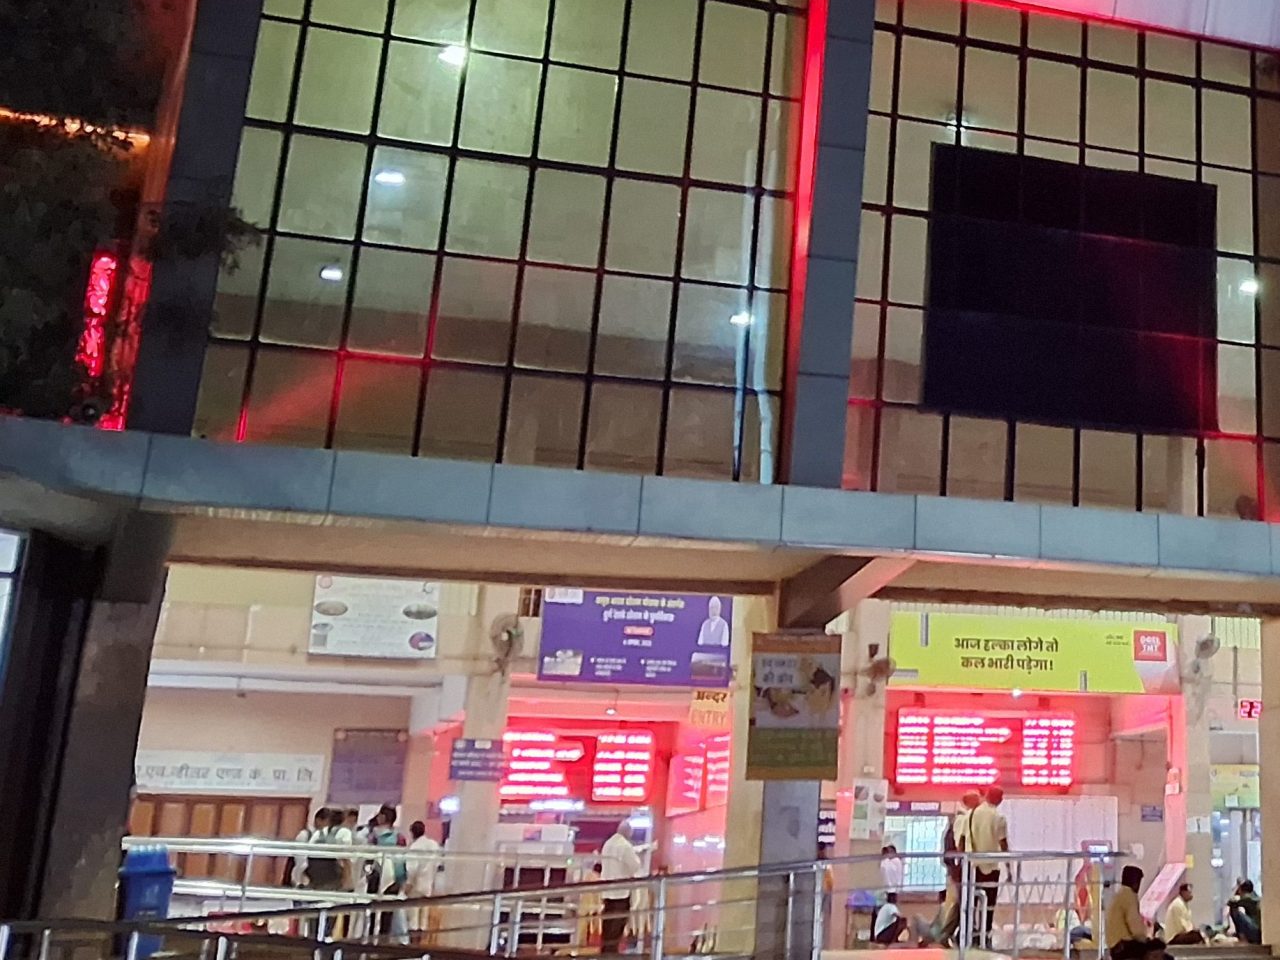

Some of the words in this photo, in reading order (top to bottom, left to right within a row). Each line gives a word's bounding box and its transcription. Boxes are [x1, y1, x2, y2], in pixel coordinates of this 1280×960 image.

[954, 637, 981, 651] आज
[983, 637, 1015, 652] हल्का
[1017, 636, 1044, 653] लोगे
[1046, 637, 1059, 653] तो
[961, 656, 986, 669] कल
[988, 655, 1013, 670] भारी
